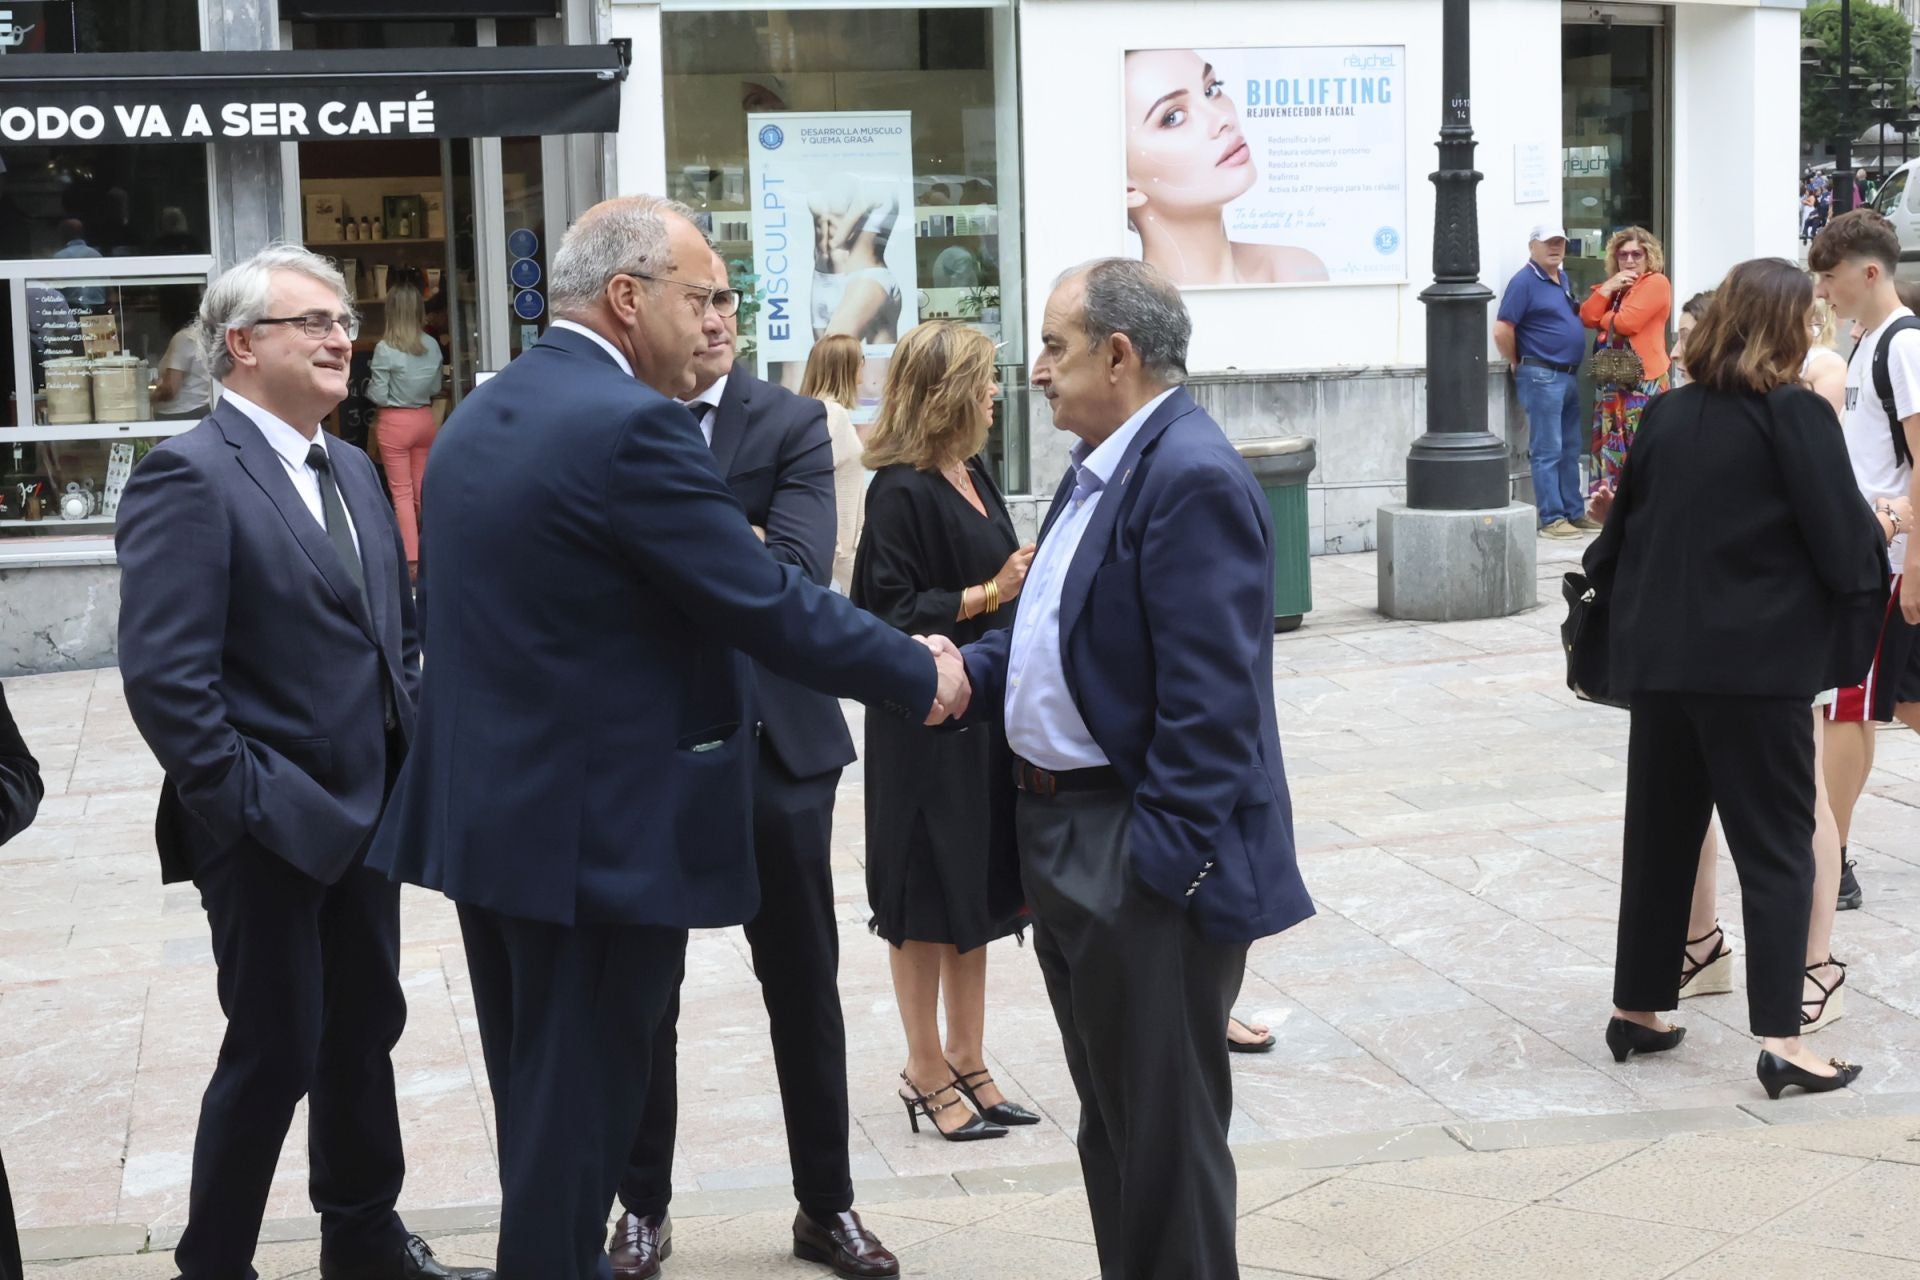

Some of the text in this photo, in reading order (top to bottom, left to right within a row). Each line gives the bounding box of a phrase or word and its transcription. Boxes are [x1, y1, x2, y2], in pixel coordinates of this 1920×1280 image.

[1246, 76, 1392, 106] BIOLIFTING
[0, 90, 435, 141] ODO VA A SER CAFÉ
[1246, 106, 1355, 118] REJUVENECEDOR FACIAL
[800, 126, 902, 137] DESARROLLA MUSCULO
[801, 135, 874, 144] Y QUEMA GRASA
[1380, 233, 1393, 244] 12
